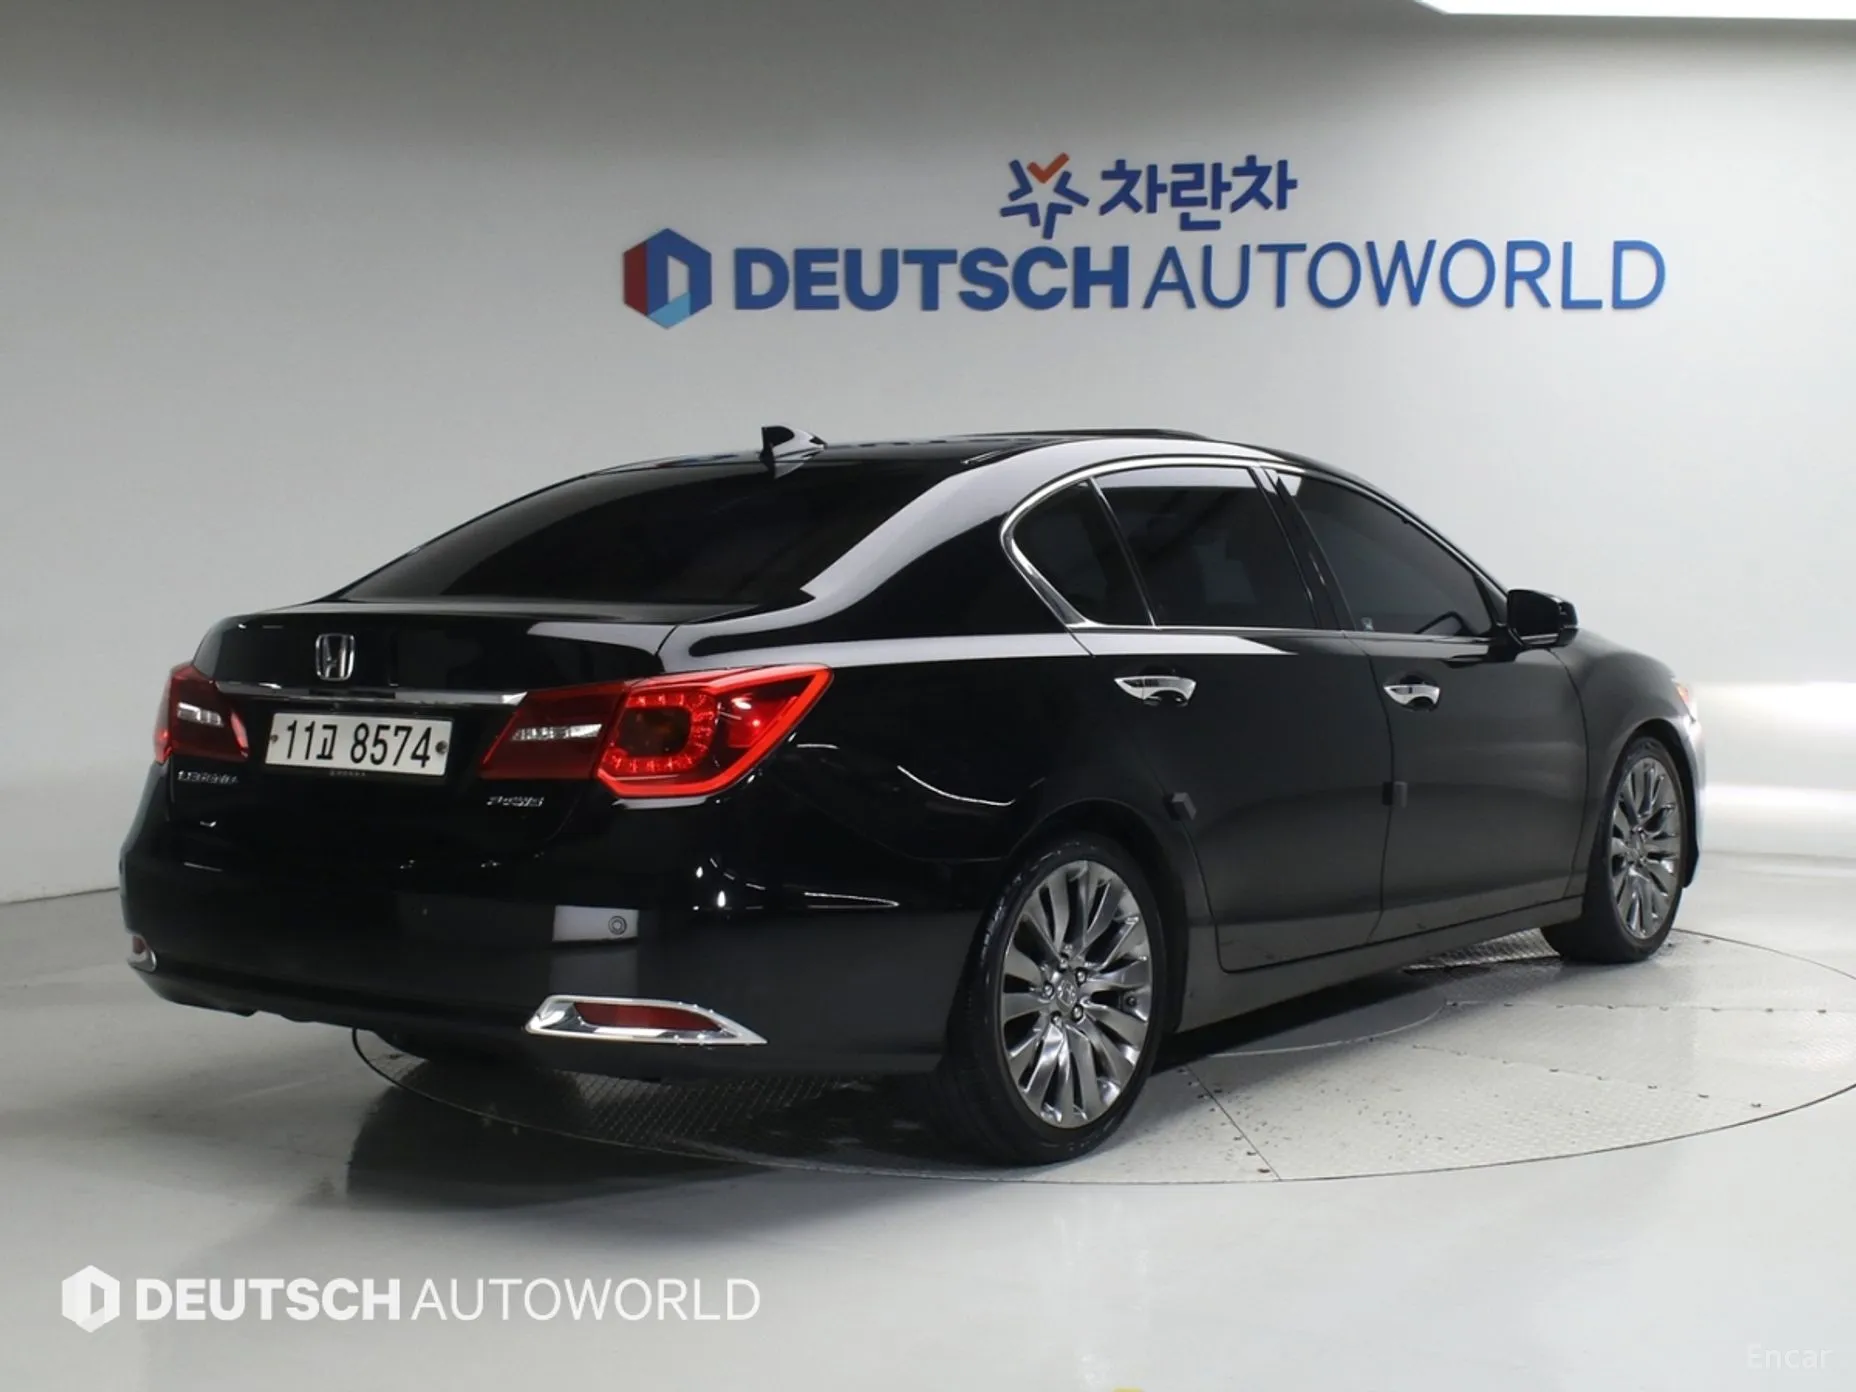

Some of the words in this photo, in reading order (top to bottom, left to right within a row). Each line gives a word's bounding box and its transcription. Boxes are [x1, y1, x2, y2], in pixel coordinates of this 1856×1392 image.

[1099, 155, 1298, 231] 차란차
[734, 246, 1131, 311] DEUTSCH
[1142, 238, 1667, 310] AUTOWORLD
[286, 719, 338, 761] 11고
[350, 722, 433, 768] 8574
